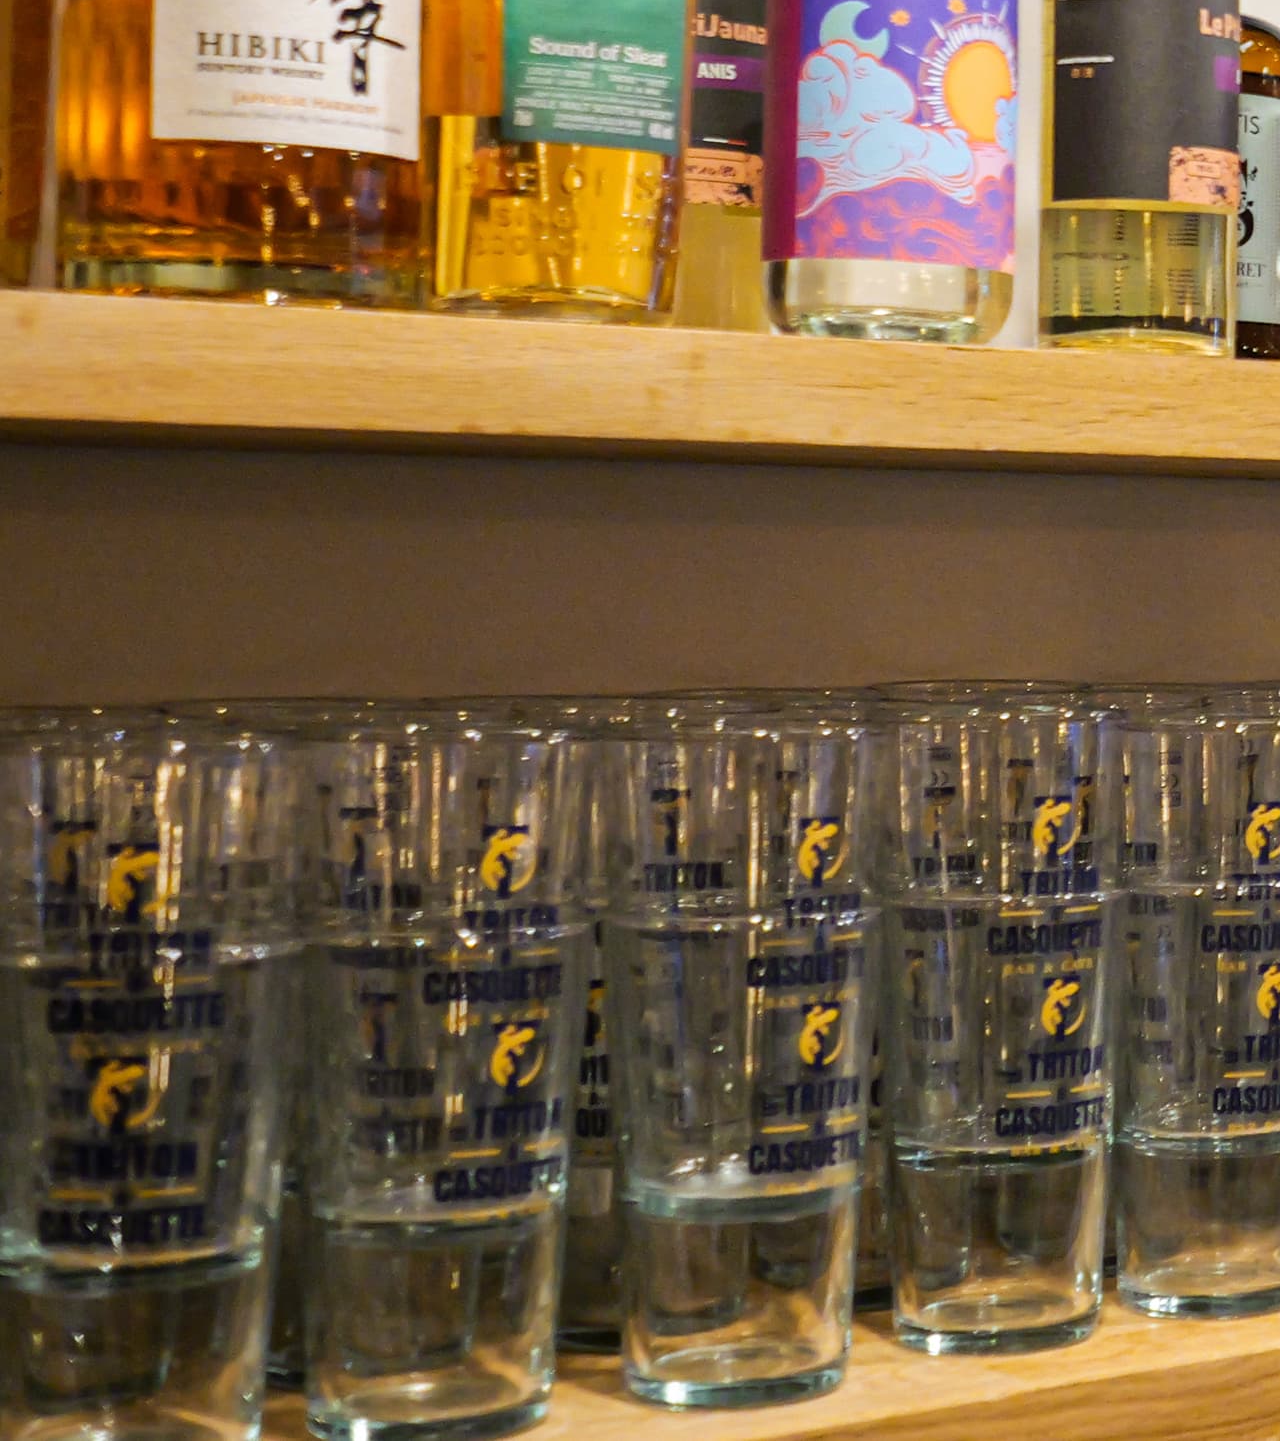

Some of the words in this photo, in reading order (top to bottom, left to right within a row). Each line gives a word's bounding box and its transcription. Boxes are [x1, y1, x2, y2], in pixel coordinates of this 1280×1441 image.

[196, 31, 326, 65] HIBIKI
[529, 37, 597, 59] Sound
[599, 44, 620, 60] of
[697, 63, 738, 81] ANIS
